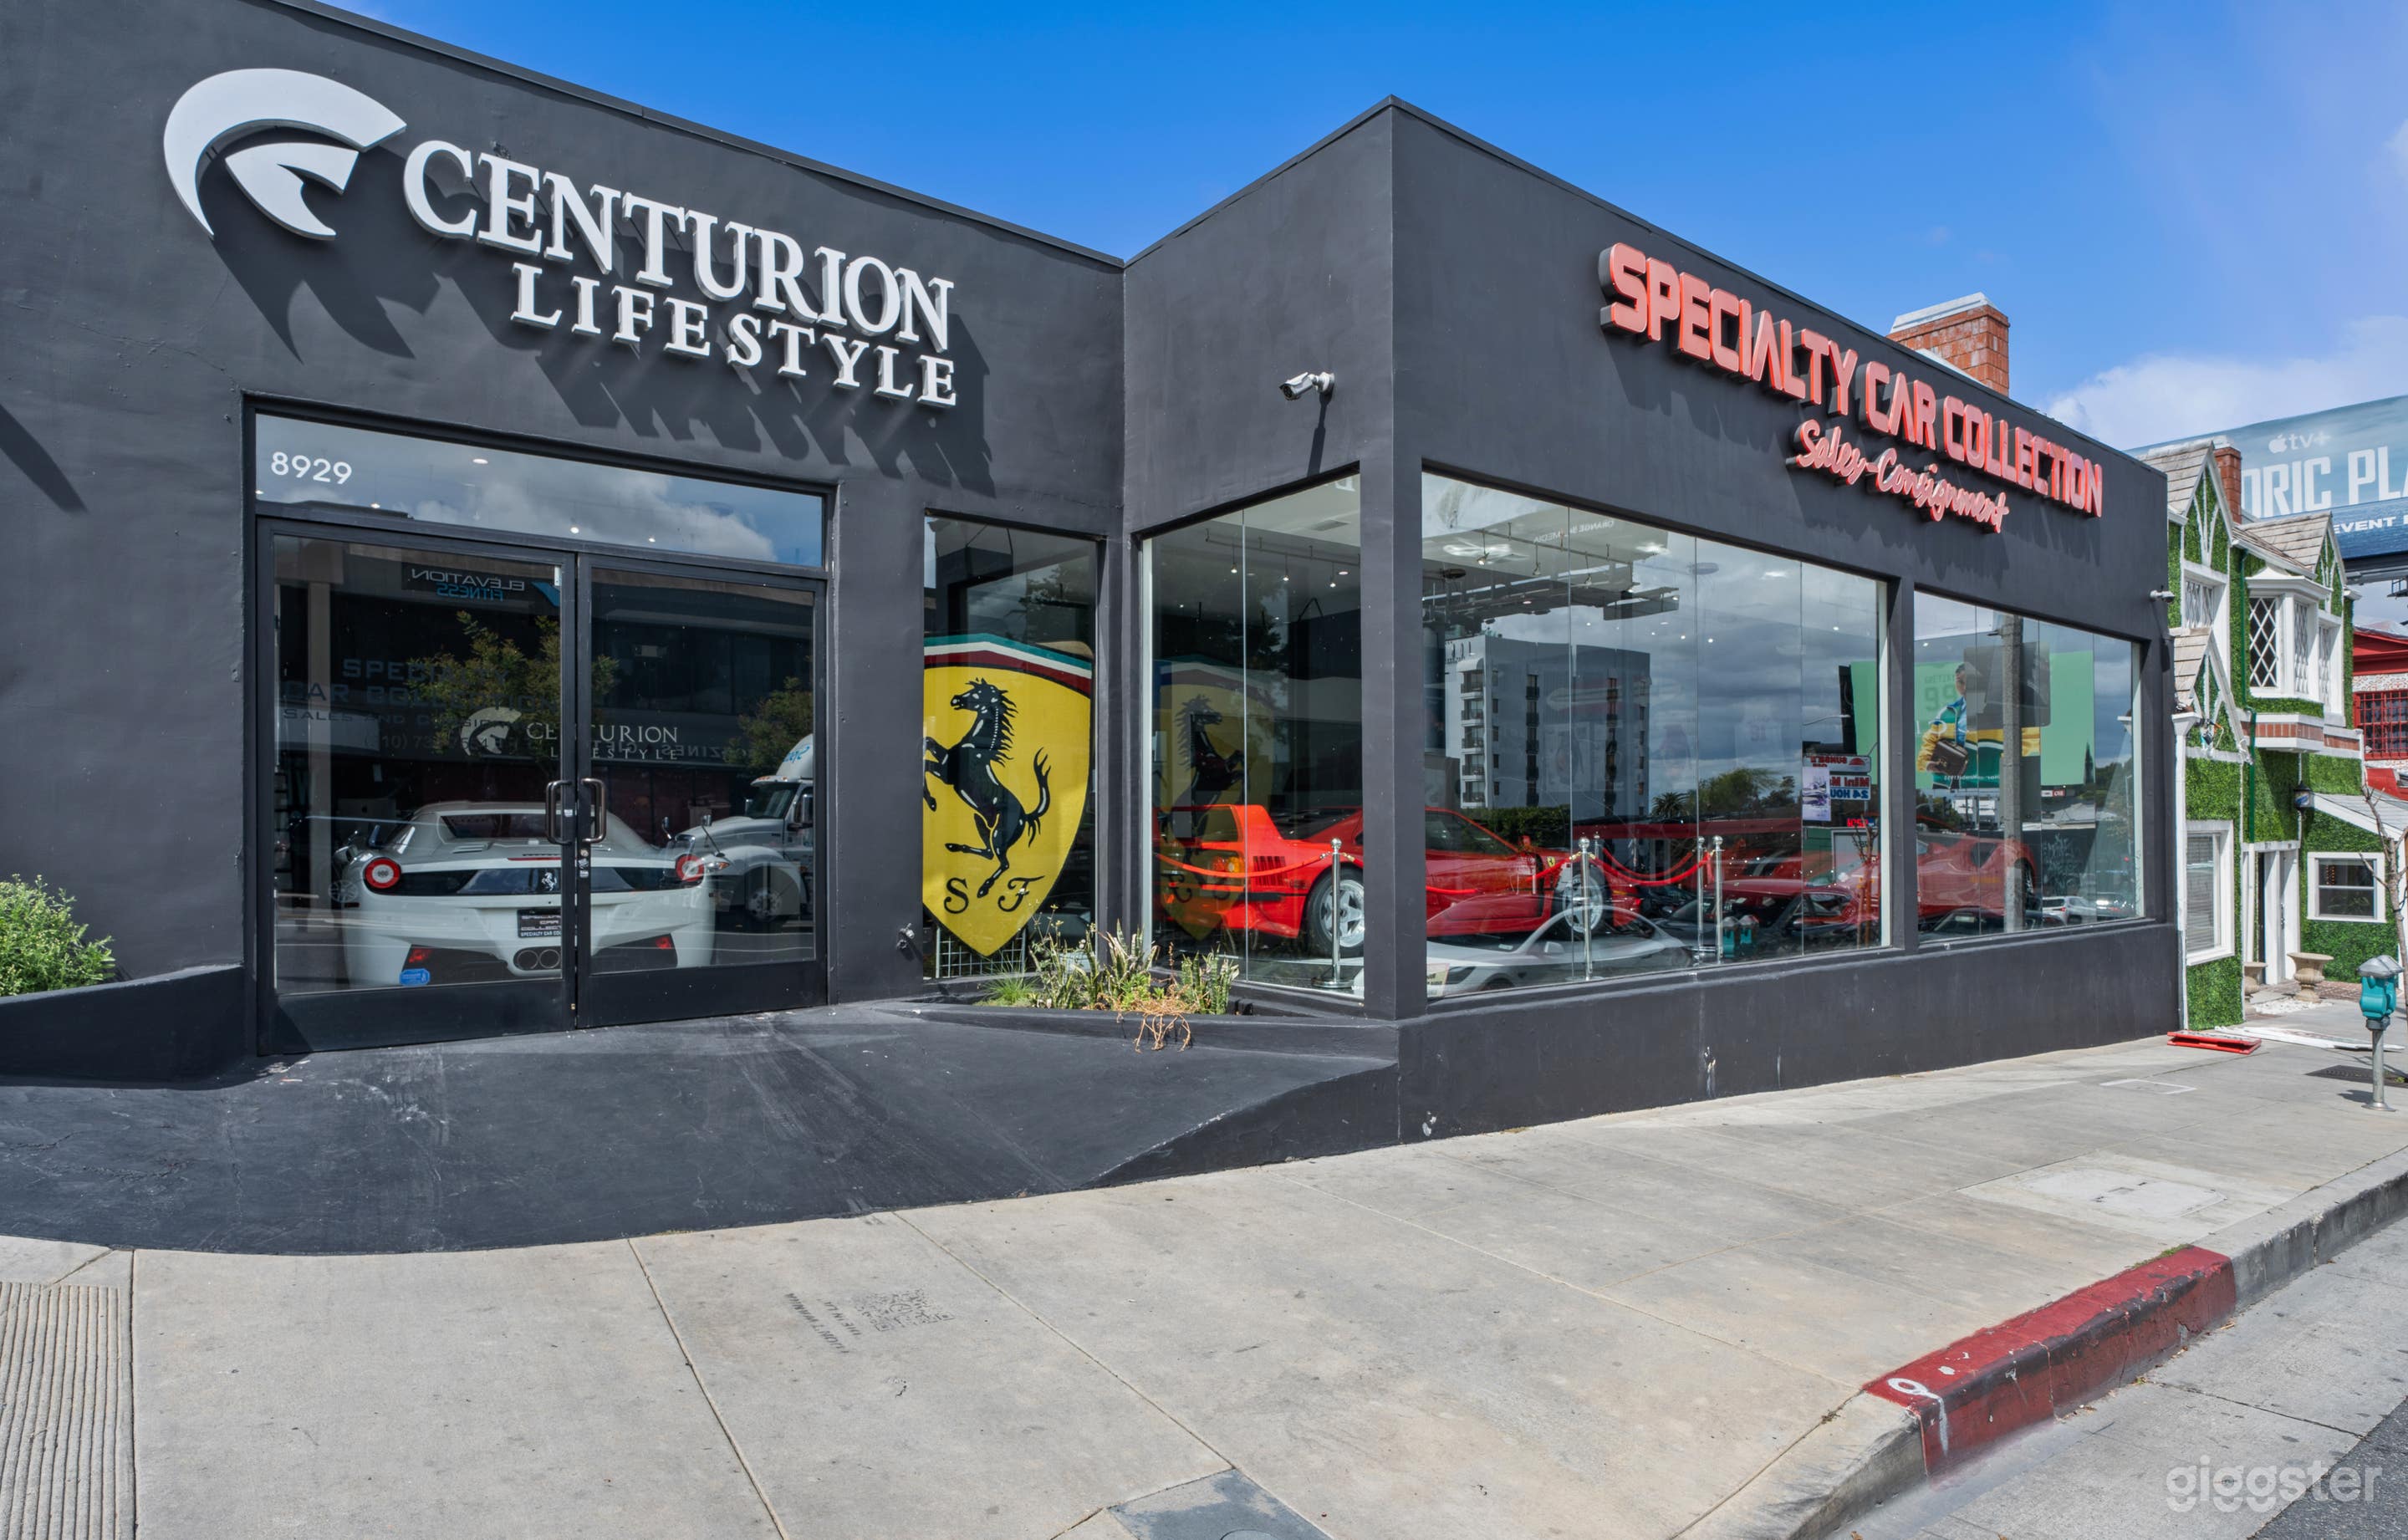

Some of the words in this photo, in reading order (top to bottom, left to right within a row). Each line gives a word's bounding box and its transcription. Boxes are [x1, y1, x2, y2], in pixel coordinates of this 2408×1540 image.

[403, 140, 955, 352] CENTURION
[509, 262, 957, 407] LIFESTYLE
[1600, 242, 1858, 416] SPECIALTY
[1860, 361, 1937, 451] CAR
[1940, 395, 2104, 518] COLLECTION
[270, 451, 354, 486] 8929
[526, 722, 678, 743] CEURION
[550, 746, 678, 760] LESTYLE
[943, 877, 969, 914] S
